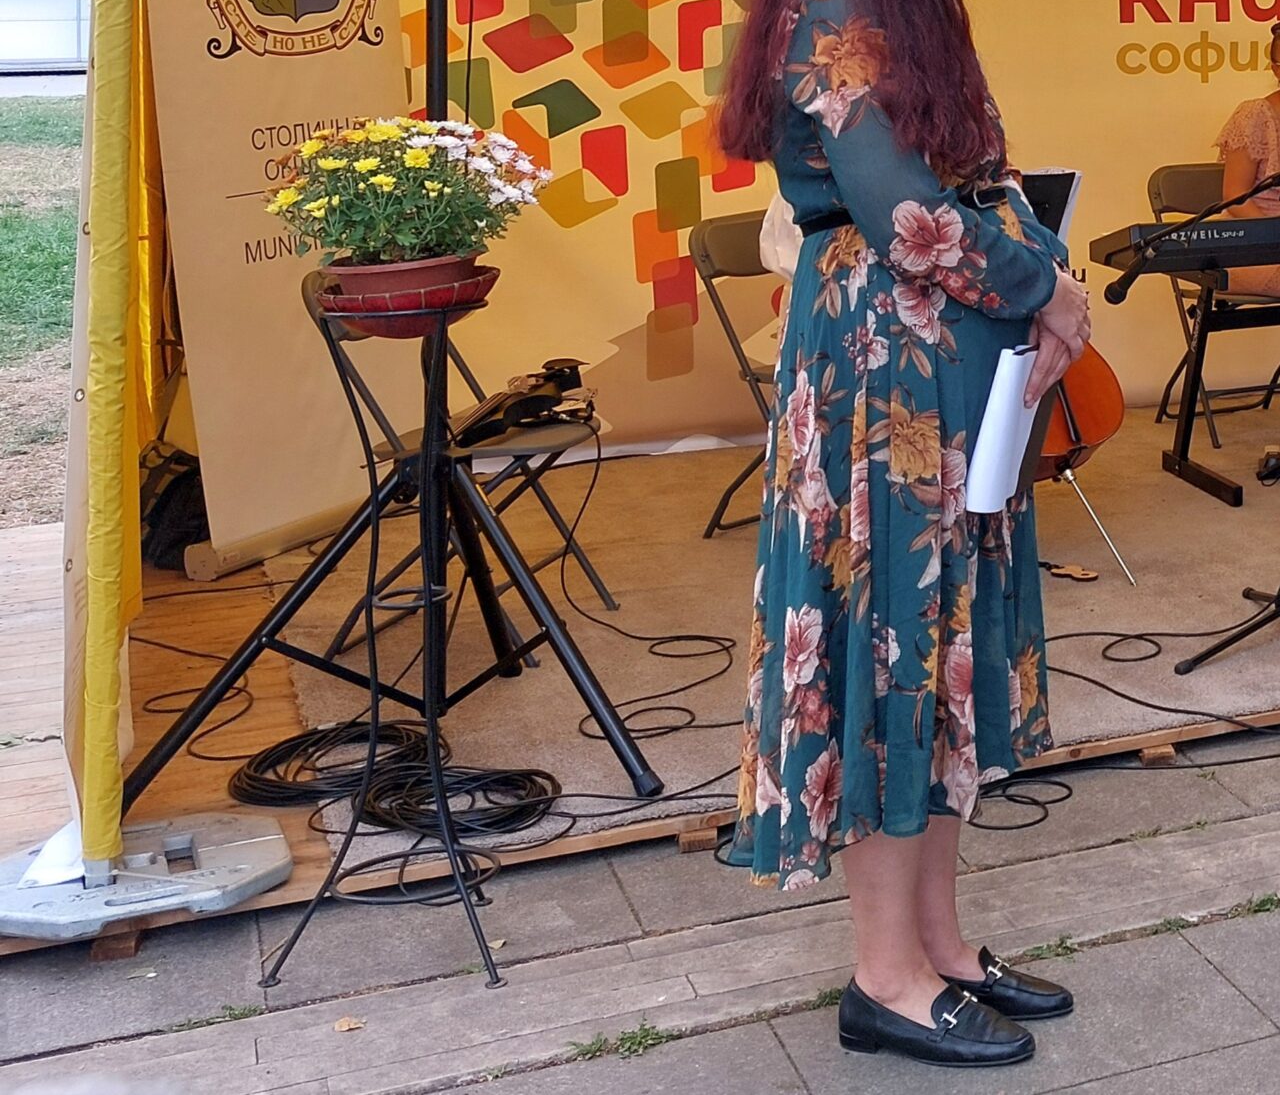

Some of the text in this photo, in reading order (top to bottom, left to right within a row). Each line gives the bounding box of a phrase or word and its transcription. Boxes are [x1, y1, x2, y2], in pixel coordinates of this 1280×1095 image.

[272, 38, 295, 51] НО
[302, 33, 330, 50] НЕ
[1161, 229, 1220, 241] RZWEIL
